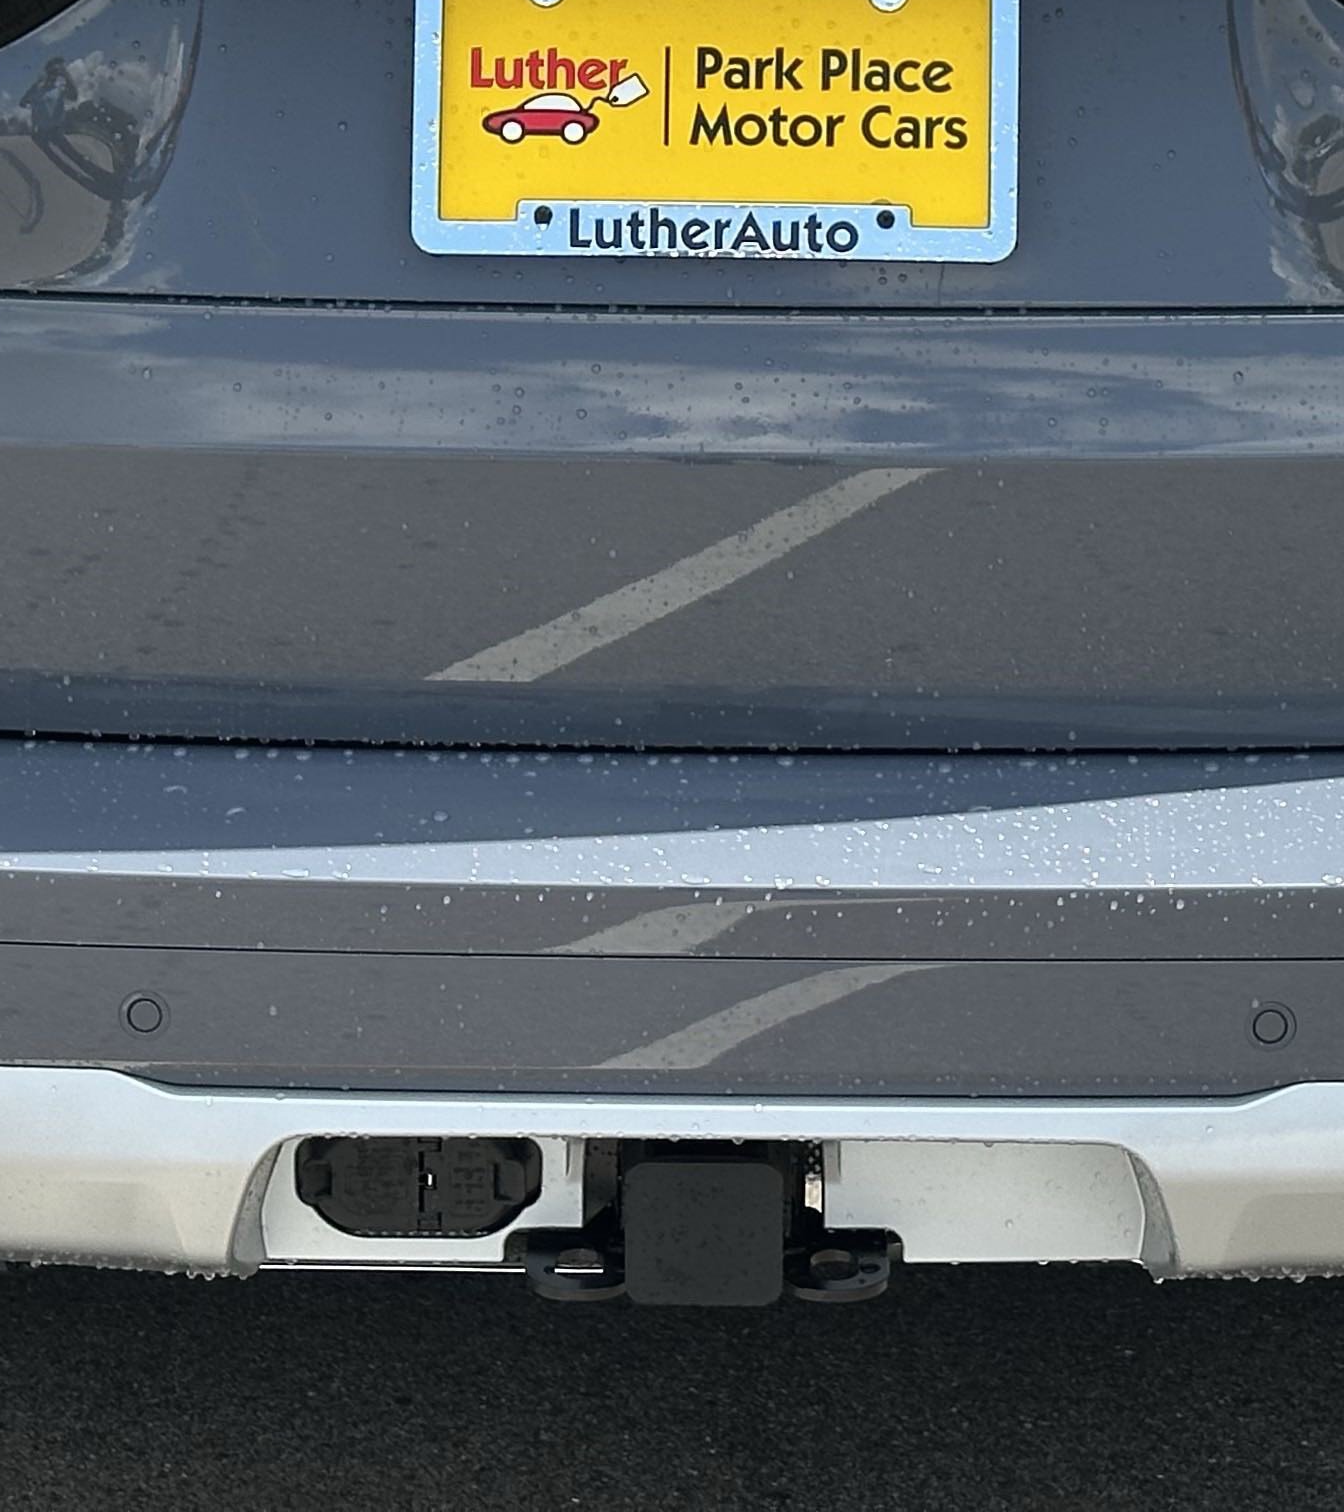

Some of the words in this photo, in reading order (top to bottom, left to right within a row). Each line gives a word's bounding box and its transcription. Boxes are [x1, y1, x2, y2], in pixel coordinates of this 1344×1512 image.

[470, 47, 628, 90] Luther
[696, 47, 803, 92] Park
[822, 49, 954, 93] Place
[690, 104, 845, 147] Motor
[862, 106, 968, 150] Cars
[569, 208, 860, 254] LutherAuto
